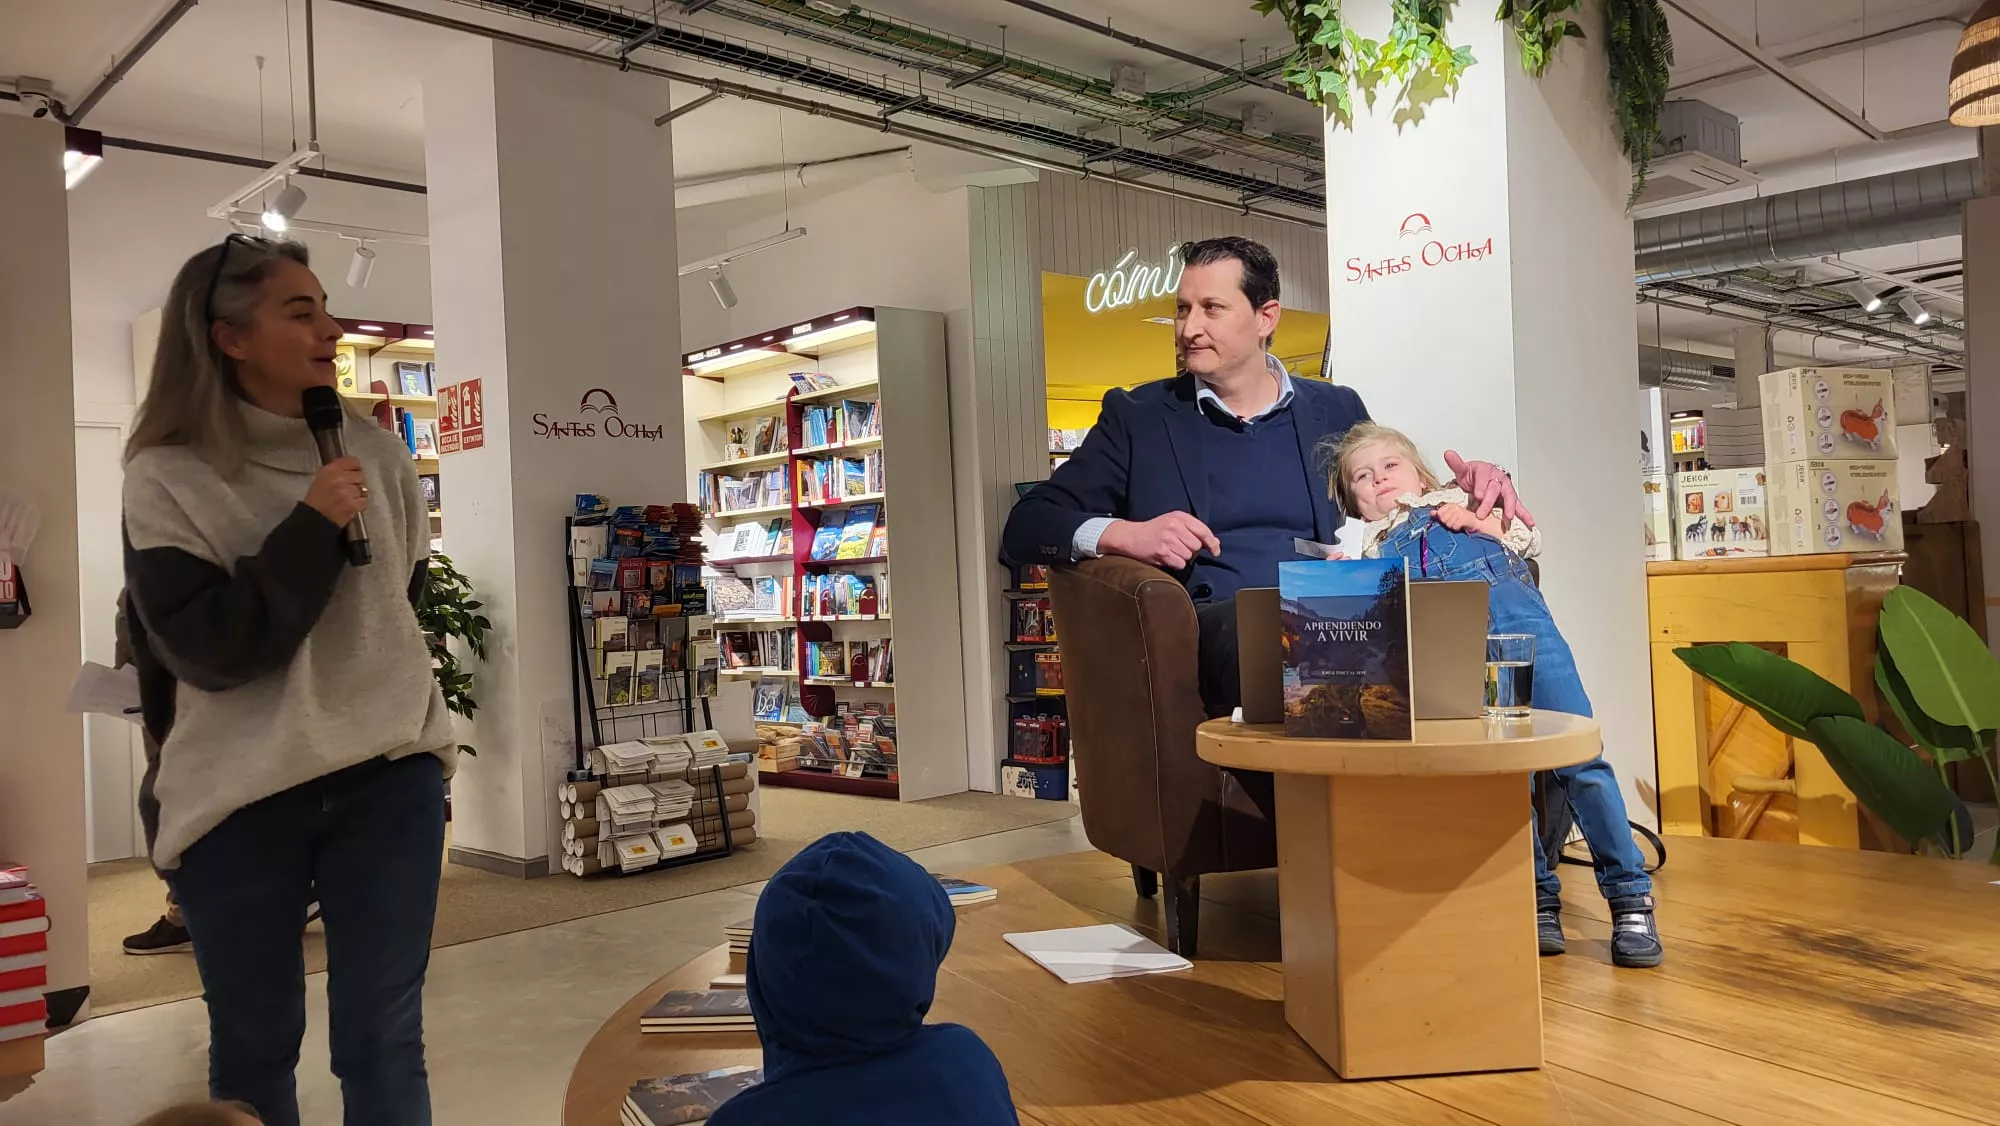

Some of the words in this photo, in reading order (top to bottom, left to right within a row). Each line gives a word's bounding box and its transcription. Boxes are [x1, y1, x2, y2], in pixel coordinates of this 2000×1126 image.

[1086, 246, 1185, 312] cómi
[1304, 621, 1382, 631] APRENDIENDO
[1317, 631, 1327, 642] A
[1330, 631, 1369, 642] VIVIR
